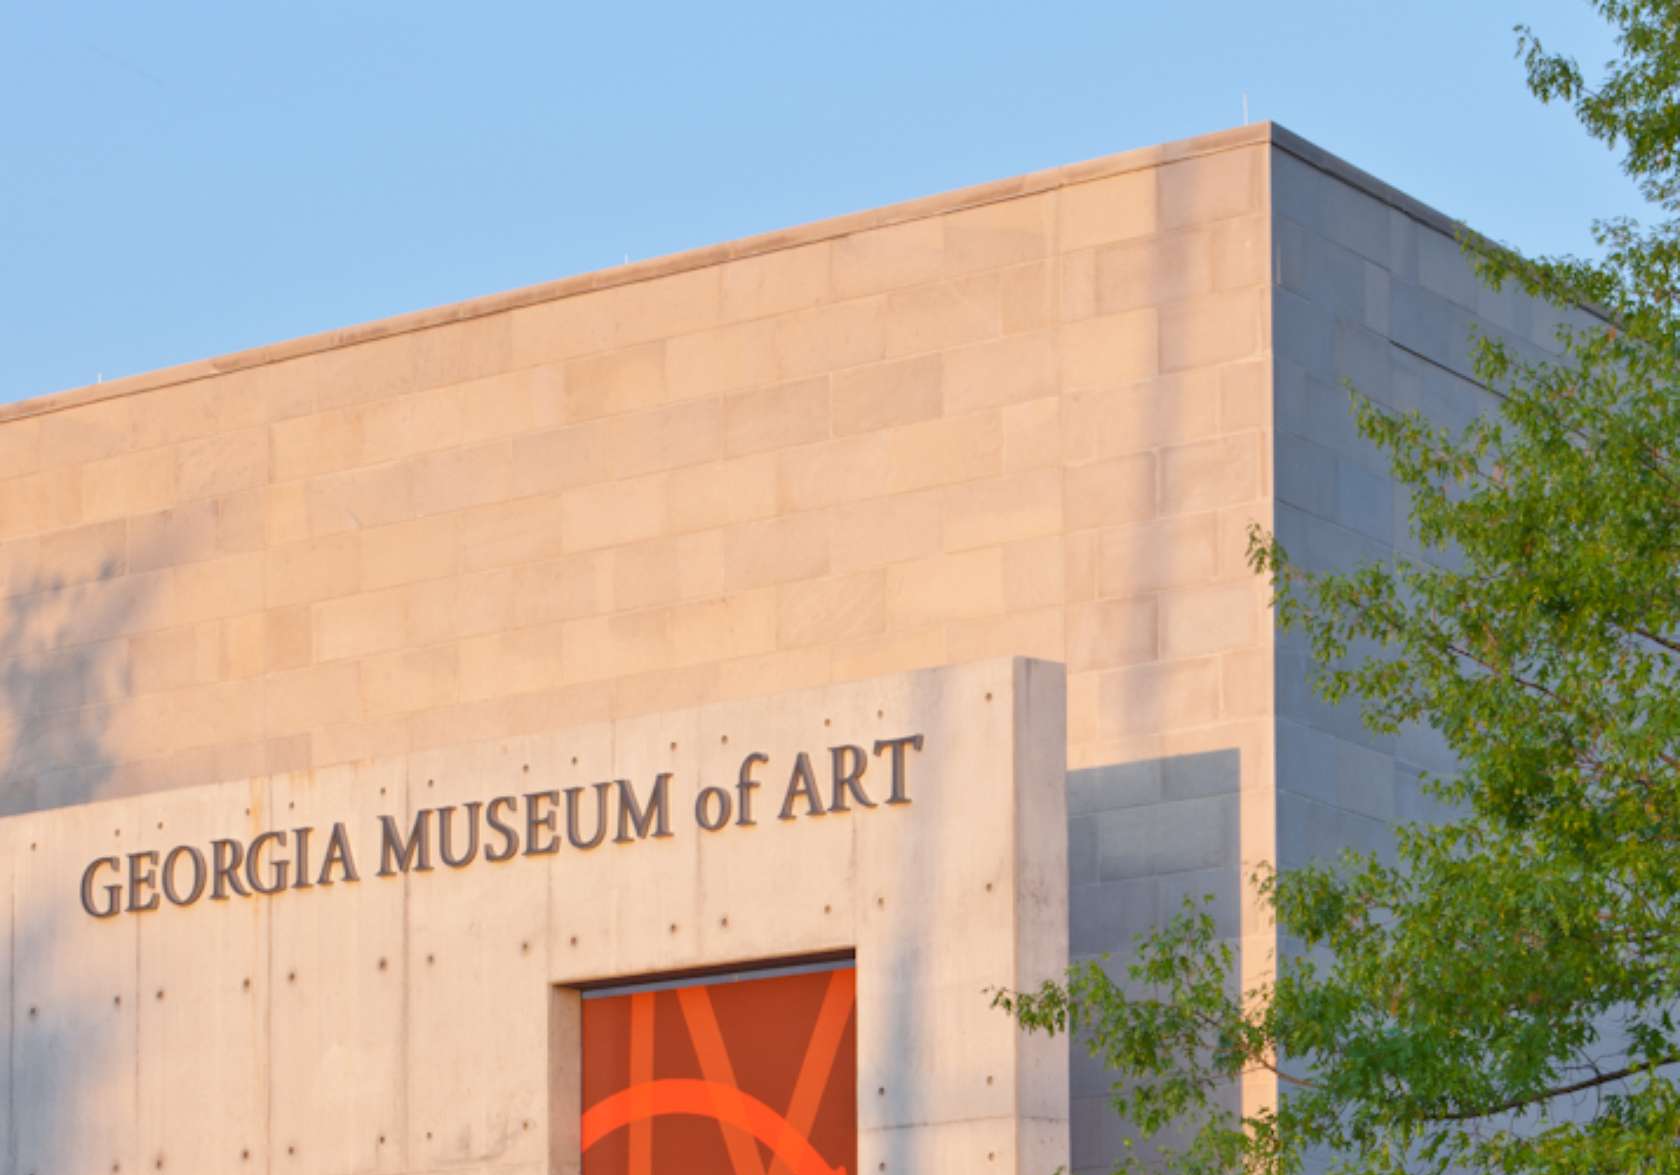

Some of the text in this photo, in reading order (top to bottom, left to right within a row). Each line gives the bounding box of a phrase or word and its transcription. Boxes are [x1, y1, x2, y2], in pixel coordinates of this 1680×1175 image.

[81, 733, 924, 919] GEORGIA MUSEUM of ART
